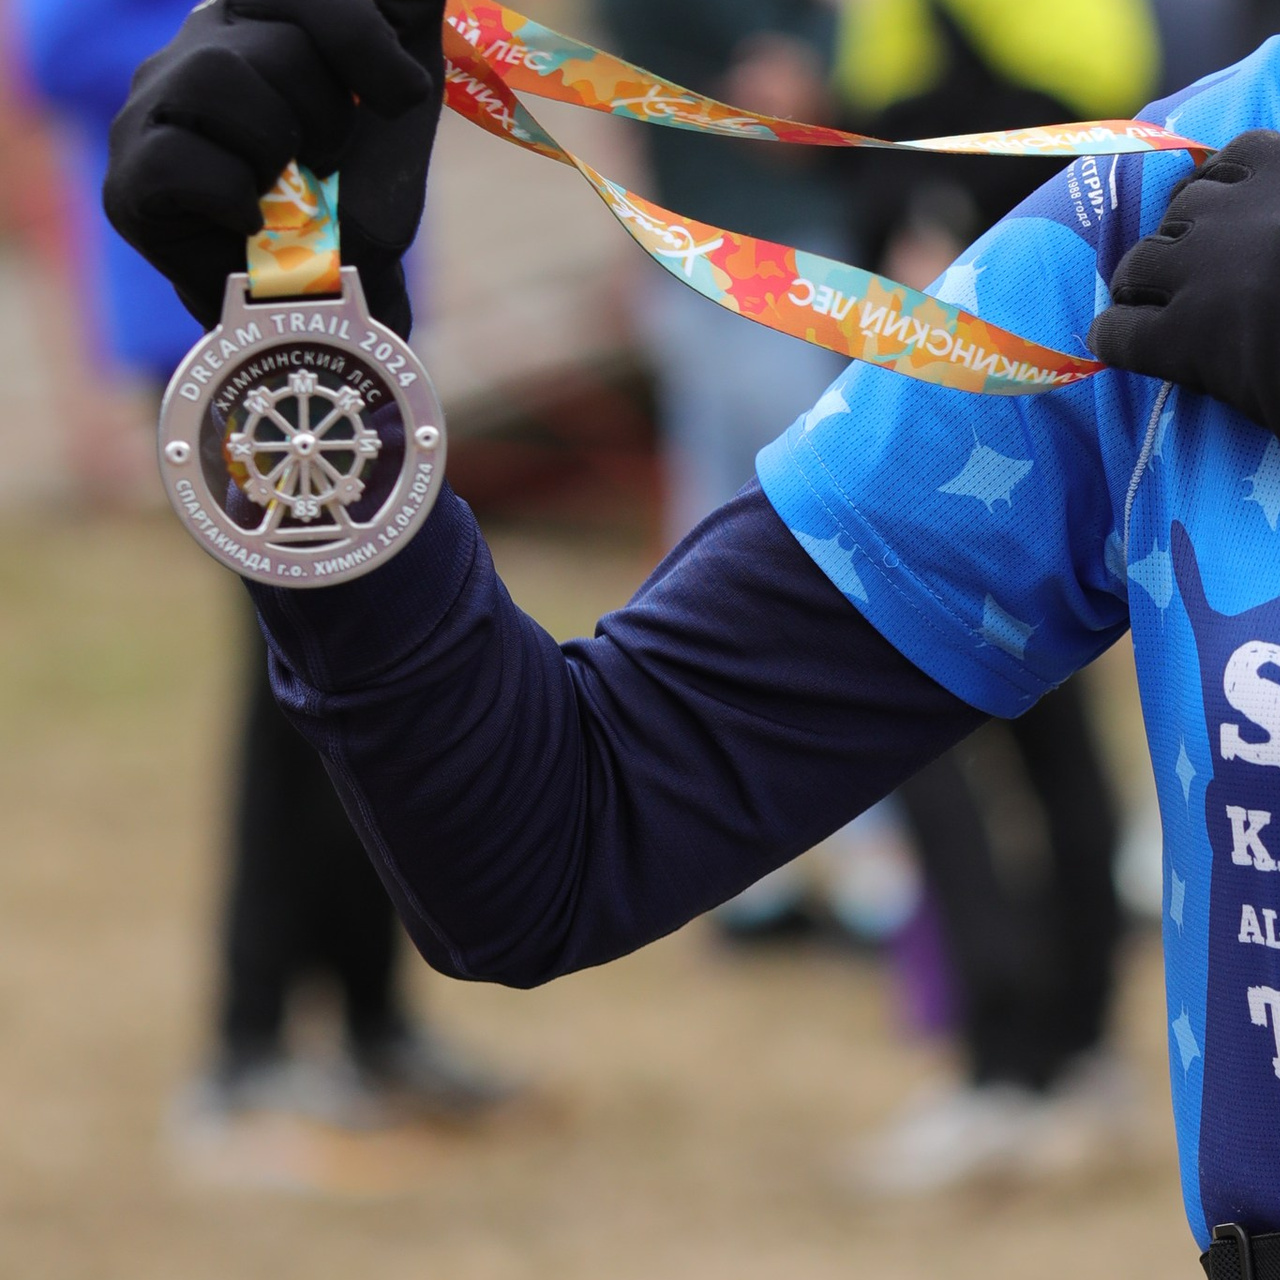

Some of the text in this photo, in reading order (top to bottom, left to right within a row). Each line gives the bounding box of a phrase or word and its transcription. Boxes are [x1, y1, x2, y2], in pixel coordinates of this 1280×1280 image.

[483, 40, 553, 72] ЛЕС
[1067, 179, 1082, 199] 1988
[1073, 200, 1092, 228] года
[787, 277, 858, 321] ЛЕС
[181, 313, 417, 402] DREAM TRAIL 2024
[214, 350, 382, 411] ХИМКИНСКИЙ ЛЕС
[175, 479, 271, 573] СПАРТАКИАДА
[313, 542, 377, 576] ХИМКИ
[379, 462, 433, 546] 14.04.2024
[294, 499, 318, 517] 85
